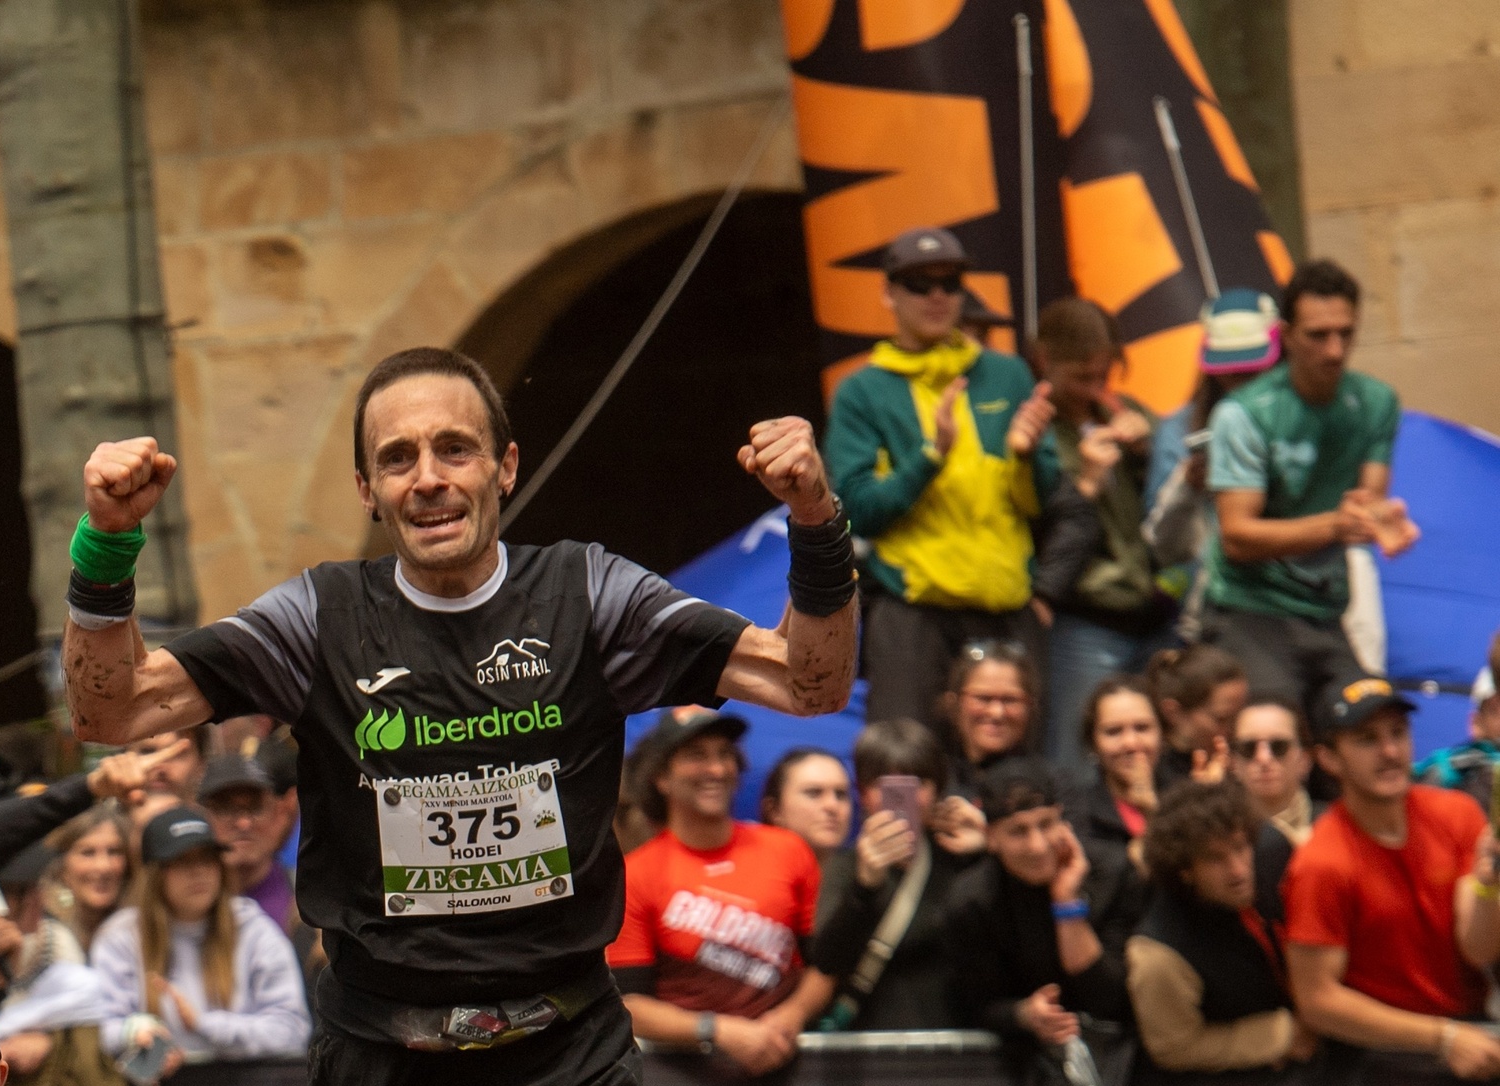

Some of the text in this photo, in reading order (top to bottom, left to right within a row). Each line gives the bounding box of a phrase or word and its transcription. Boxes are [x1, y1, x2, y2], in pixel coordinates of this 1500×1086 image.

[476, 658, 551, 685] OSIN TRAIL
[414, 700, 563, 746] Iberdrola
[393, 767, 541, 799] ZEGAMA-AIZKORRI
[443, 799, 469, 808] MENDI
[470, 793, 513, 807] MARATOIA
[426, 803, 521, 846] 375
[451, 844, 502, 860] HODEI
[405, 855, 553, 892] ZEGAMA
[447, 894, 512, 909] SALOMON
